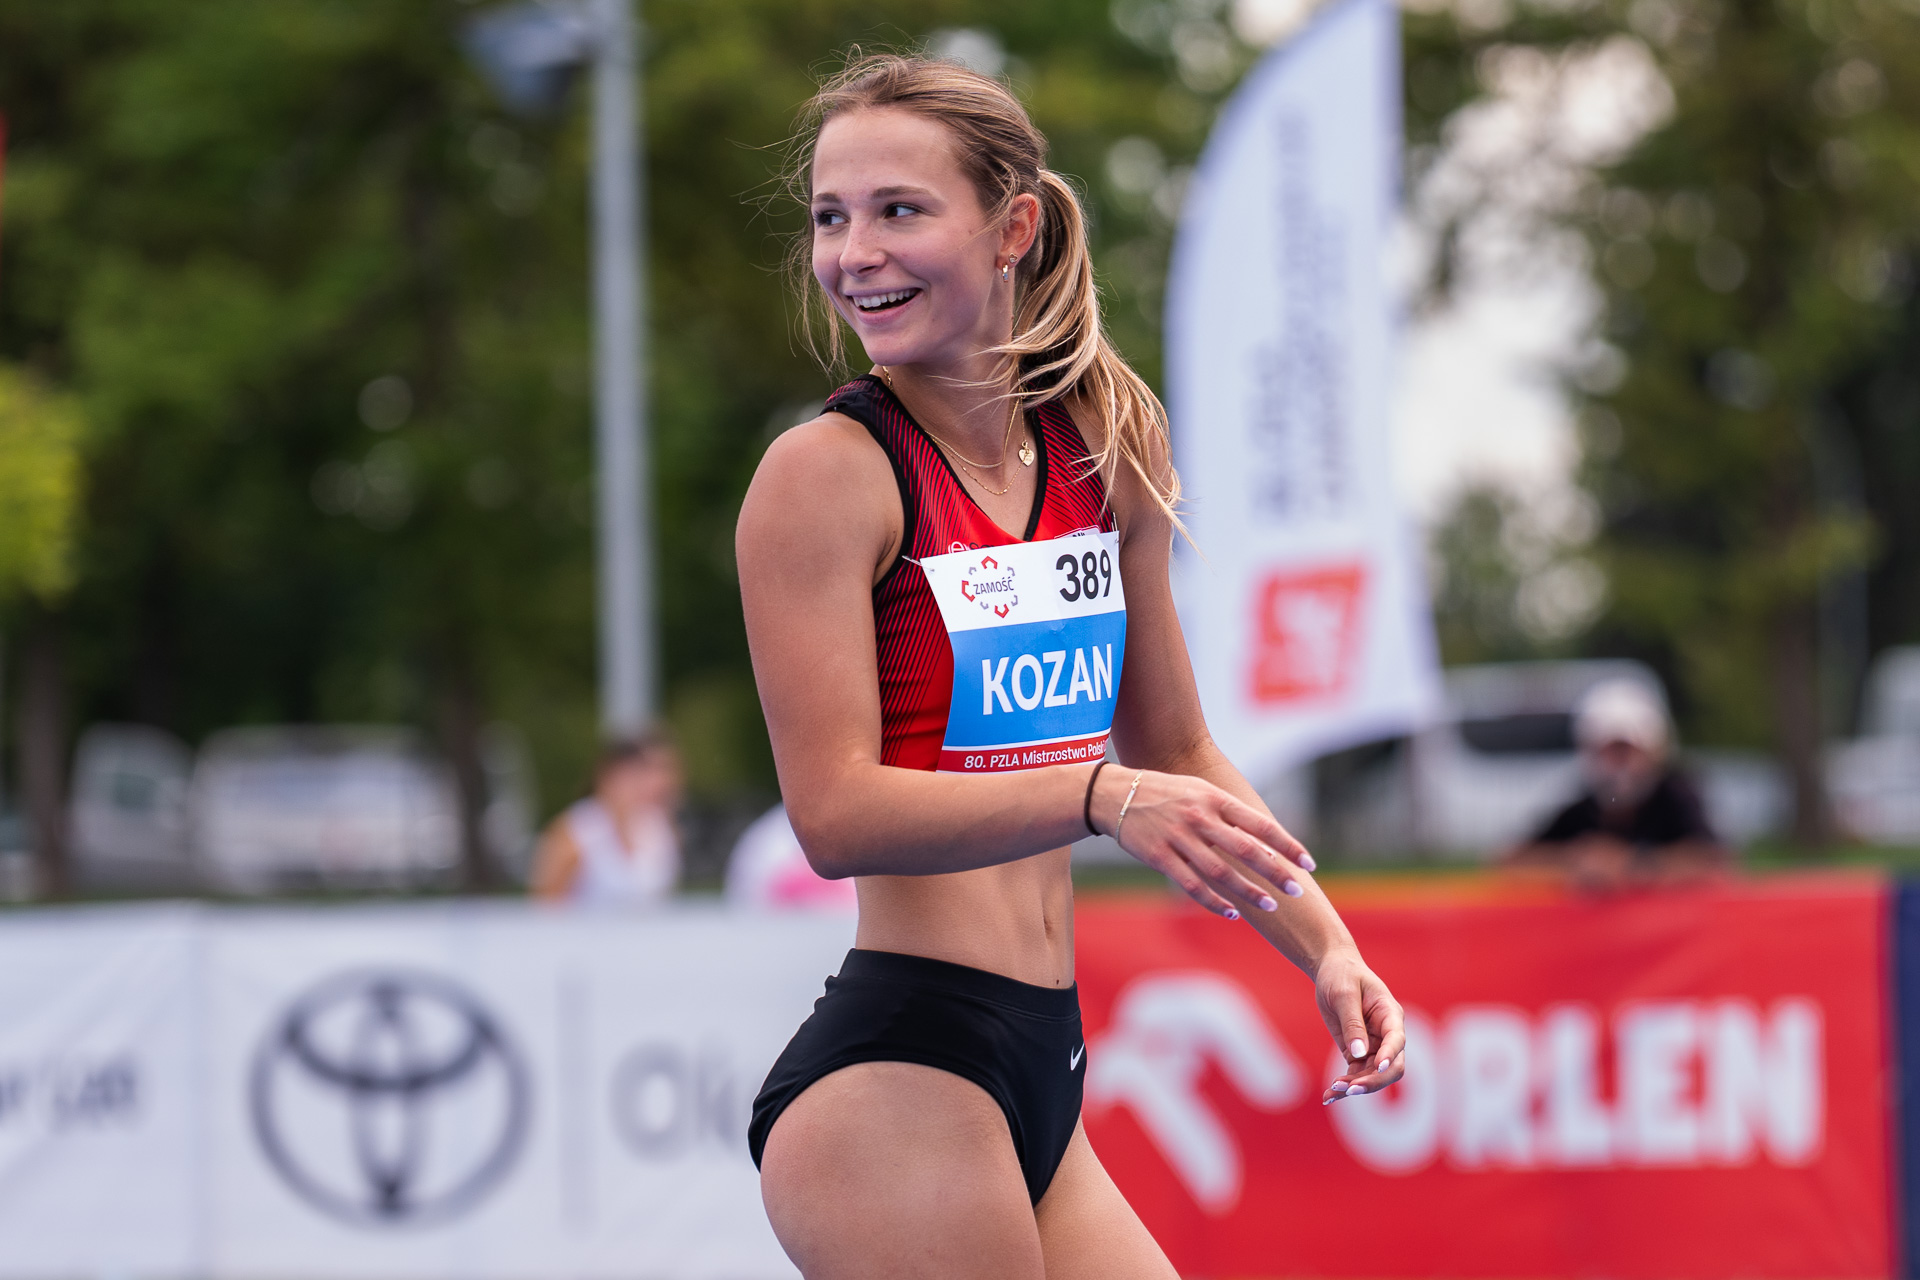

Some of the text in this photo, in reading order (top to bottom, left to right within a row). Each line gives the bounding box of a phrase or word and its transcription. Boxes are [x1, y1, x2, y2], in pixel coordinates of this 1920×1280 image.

[973, 576, 1015, 595] ZAMOŚĆ
[1056, 549, 1112, 602] 389
[981, 643, 1112, 715] KOZAN
[964, 755, 986, 769] 80.
[990, 754, 1020, 768] PZLA
[1022, 747, 1086, 766] Mistrzostwa
